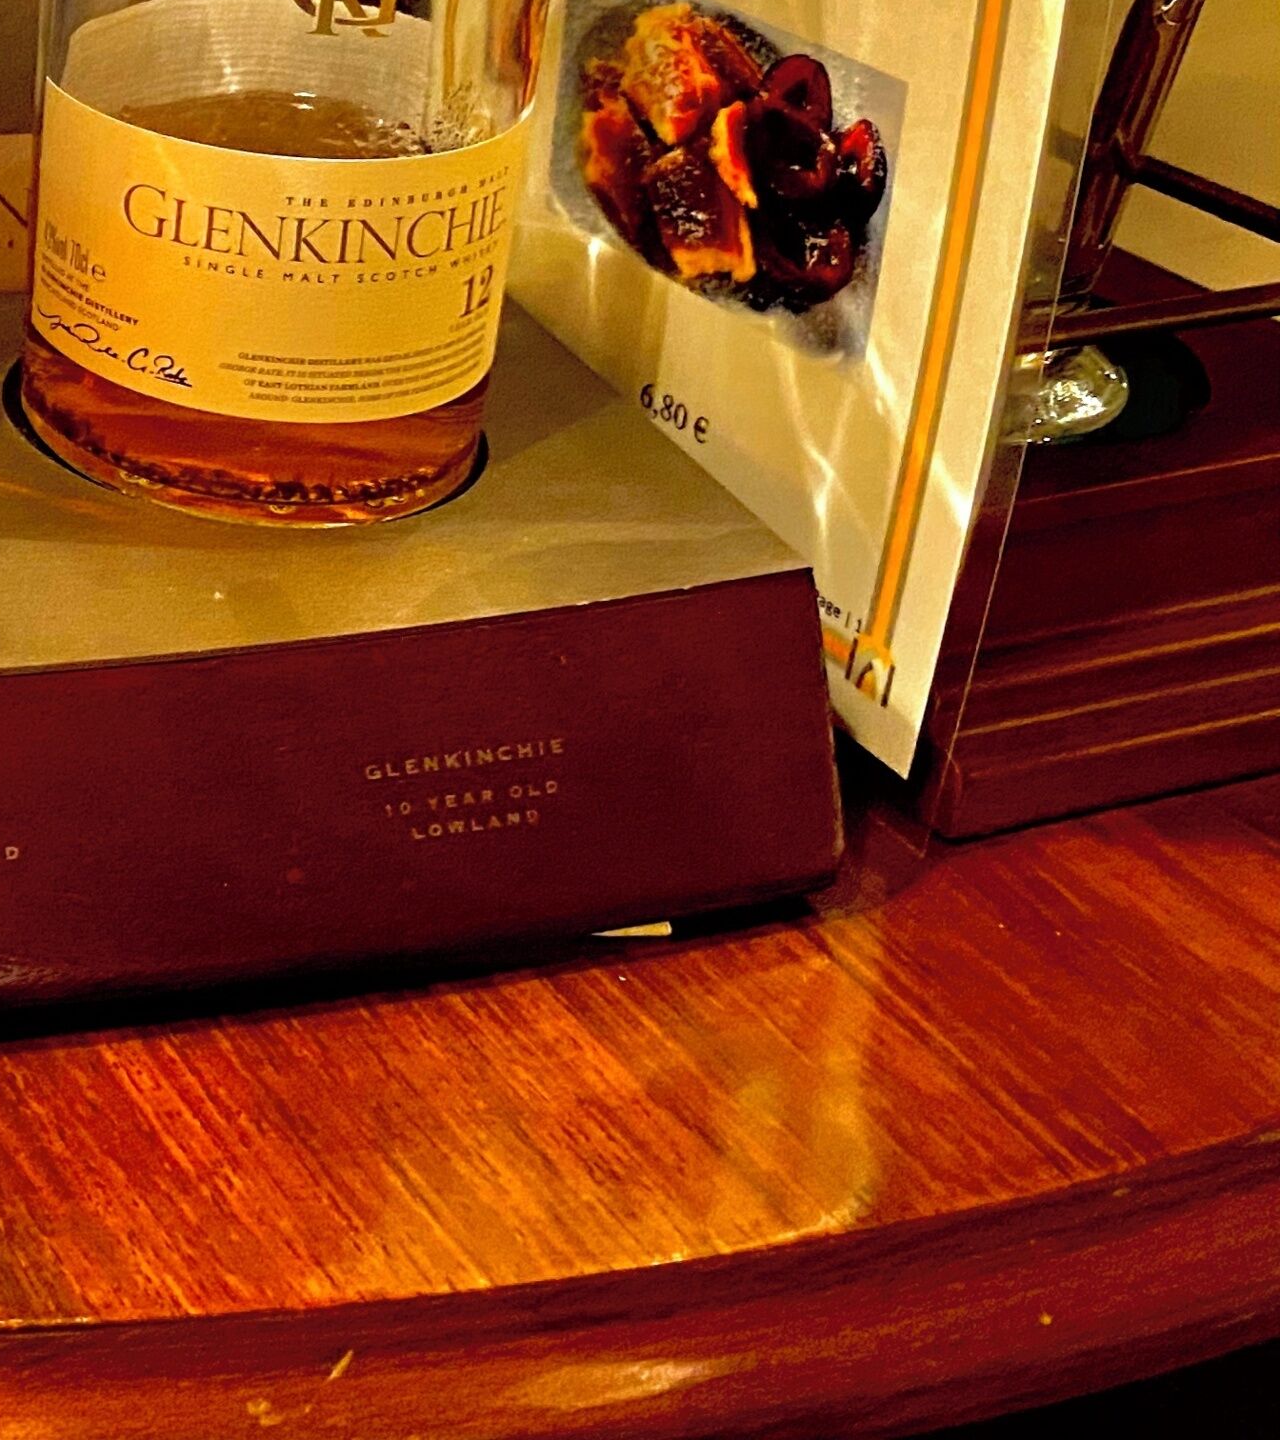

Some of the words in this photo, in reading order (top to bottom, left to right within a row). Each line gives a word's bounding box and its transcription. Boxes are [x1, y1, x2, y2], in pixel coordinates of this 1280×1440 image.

[123, 184, 508, 264] GLENKINCHIE
[184, 255, 265, 279] SINGLE
[283, 272, 339, 283] MALT
[357, 265, 438, 284] SCOTCH
[458, 264, 494, 318] 12
[640, 383, 688, 431] 6,80
[694, 416, 710, 444] €
[365, 738, 564, 780] GLENKINCHIE
[385, 801, 411, 817] 10
[428, 789, 493, 809] YEAR
[509, 780, 558, 798] OLD
[412, 810, 539, 840] LOWLAND
